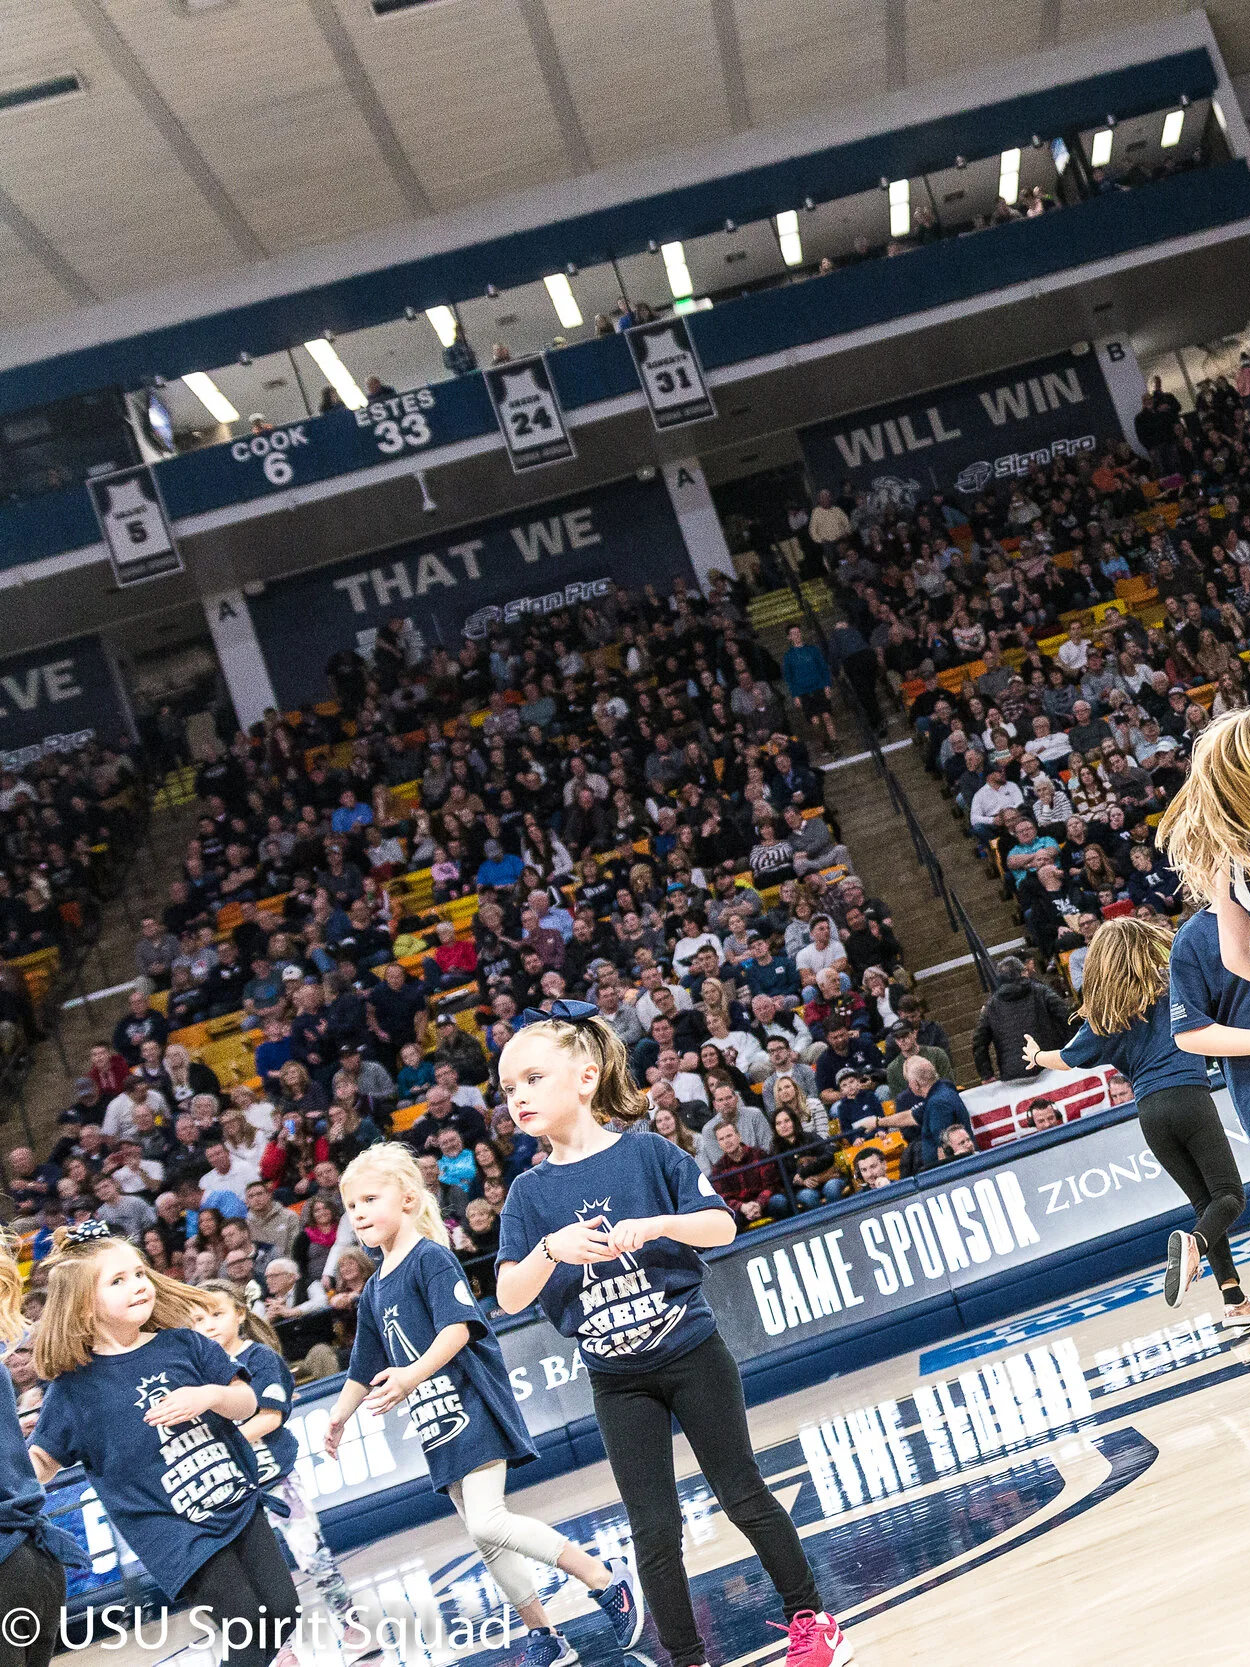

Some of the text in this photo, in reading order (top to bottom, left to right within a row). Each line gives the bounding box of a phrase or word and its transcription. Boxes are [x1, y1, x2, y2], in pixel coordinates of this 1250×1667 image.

[1106, 342, 1126, 362] B
[655, 366, 692, 393] 31
[354, 389, 435, 427] ESTES
[510, 406, 552, 435] 24
[834, 367, 1085, 468] WILL WIN
[231, 424, 308, 462] COOK
[373, 412, 431, 453] 33
[263, 451, 294, 485] 6
[678, 467, 696, 488] A
[333, 506, 603, 613] THAT WE
[219, 600, 238, 621] A
[971, 1069, 1122, 1150] ESP
[746, 1228, 865, 1336] GAME
[859, 1170, 1041, 1296] SPONSOR
[1037, 1151, 1162, 1215] ZIONS
[578, 1268, 652, 1317] MINI
[577, 1290, 670, 1337] CHEER
[539, 1349, 589, 1391] BA
[407, 1375, 456, 1408] EER
[410, 1393, 464, 1425] INIC
[420, 1421, 441, 1441] 20
